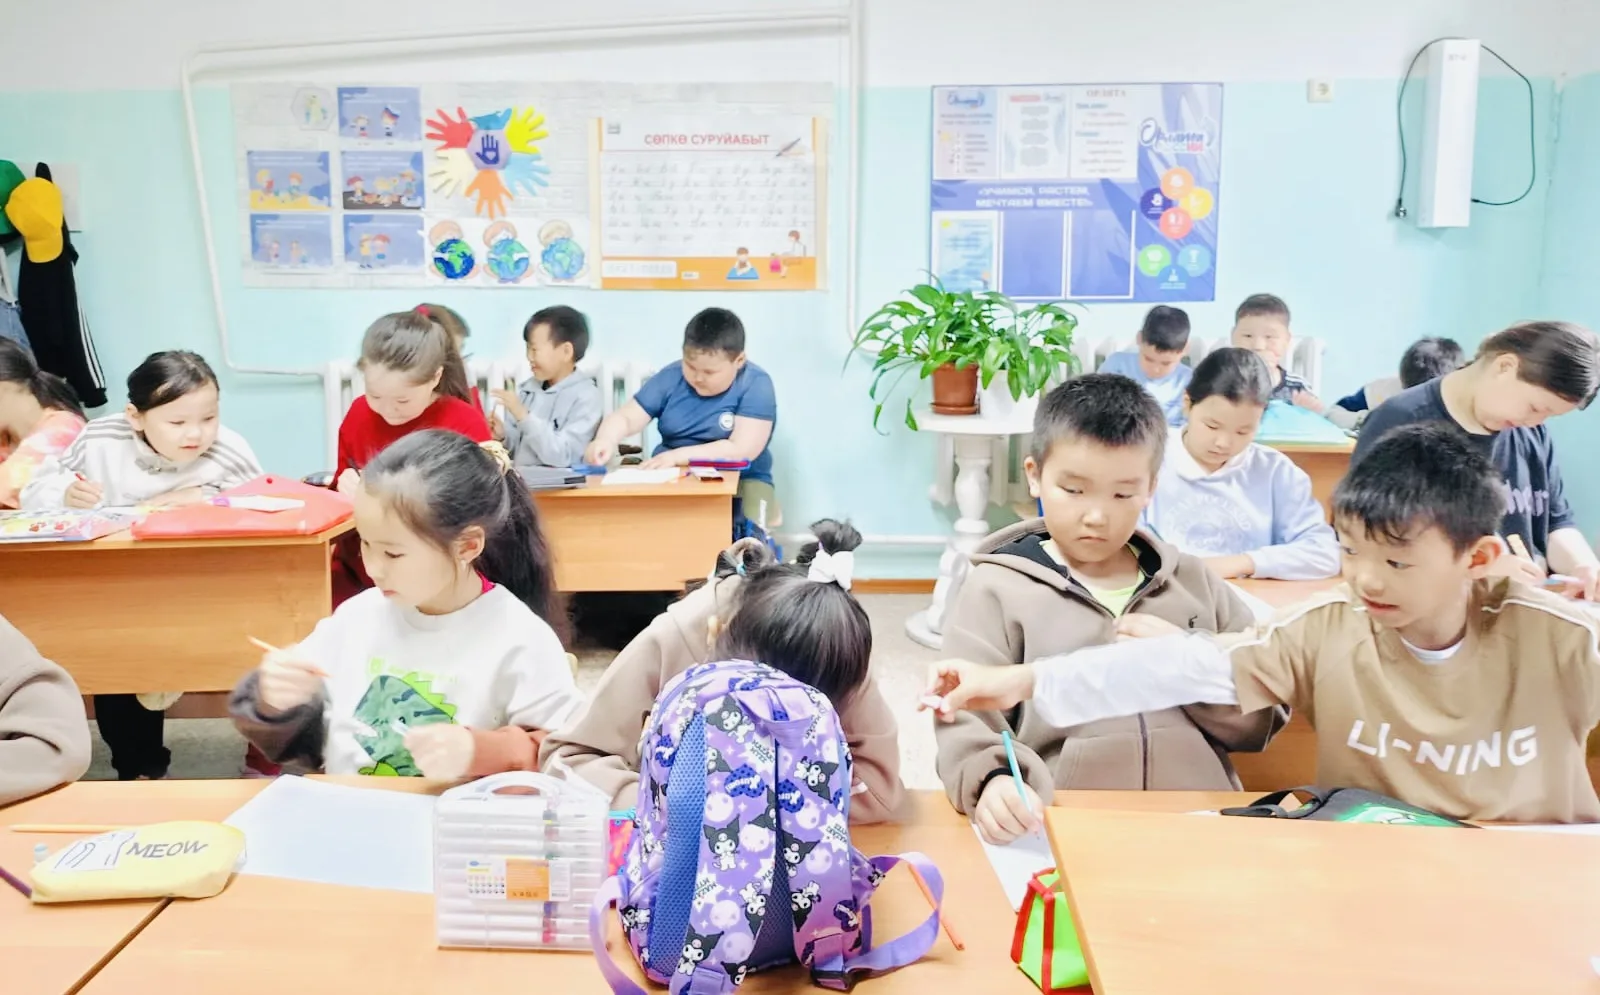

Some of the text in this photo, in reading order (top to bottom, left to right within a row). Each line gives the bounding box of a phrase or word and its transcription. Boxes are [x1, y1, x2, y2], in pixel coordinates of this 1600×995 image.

[644, 132, 770, 145] СӨПКӨ СУРУЙАБЫТ
[1347, 719, 1538, 775] LI-NING
[126, 840, 208, 858] MEOW
